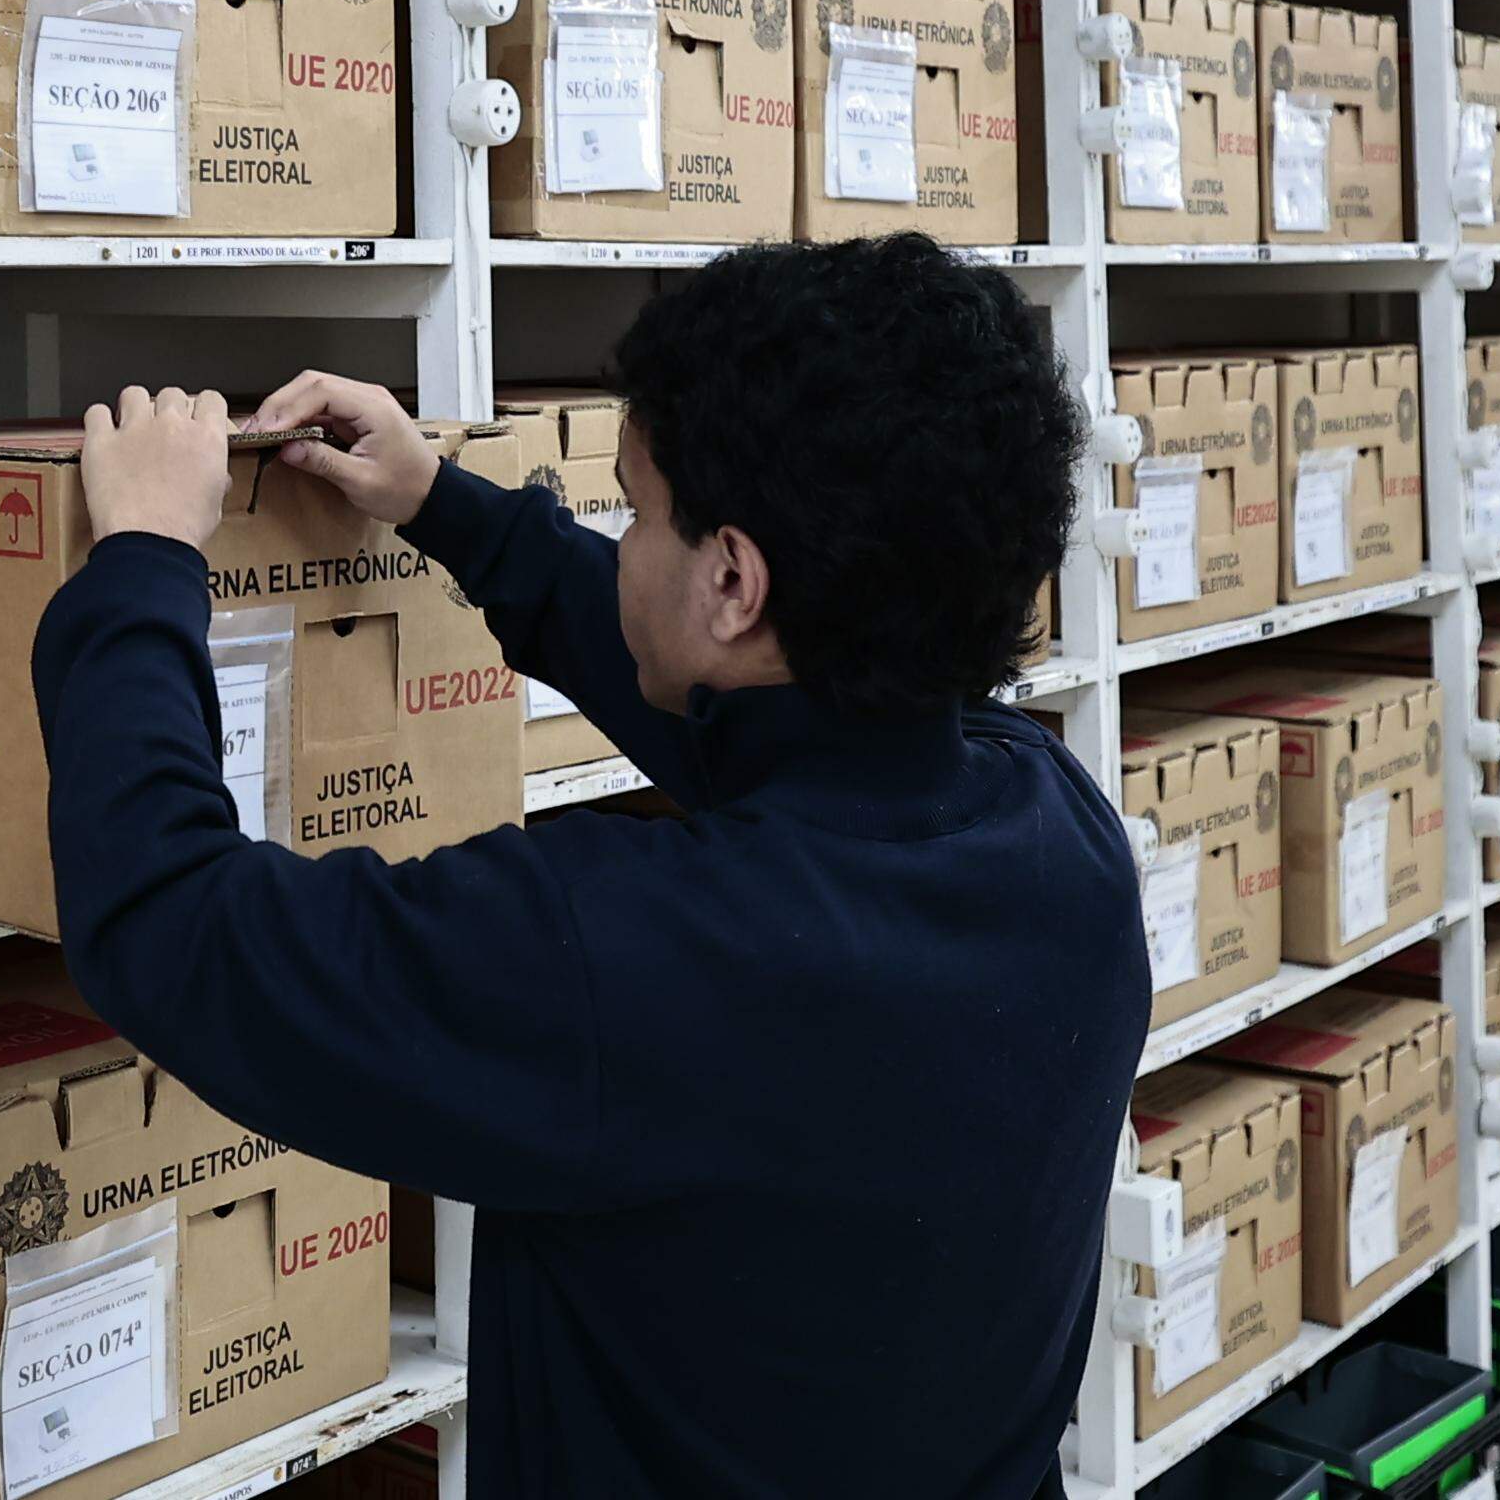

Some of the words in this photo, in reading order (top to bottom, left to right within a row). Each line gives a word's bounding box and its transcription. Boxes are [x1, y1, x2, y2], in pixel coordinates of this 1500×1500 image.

[287, 52, 325, 90] UE
[335, 57, 394, 95] 2020
[49, 83, 120, 113] SEÇÃO
[127, 88, 167, 114] 206ª
[725, 94, 753, 124] UE
[756, 98, 794, 128] 2020
[213, 125, 300, 156] JUSTIÇA
[961, 112, 983, 138] UE
[199, 157, 313, 187] ELEITORAL
[677, 154, 734, 178] JUSTIÇA
[923, 165, 969, 188] JUSTIÇA
[669, 178, 742, 205] ELEITORAL
[1191, 431, 1246, 455] ELETRÔNICA
[268, 548, 431, 595] ELETRÔNICA
[404, 666, 516, 717] UE2022
[317, 760, 415, 803] JUSTIÇA
[300, 794, 429, 844] ELEITORAL
[1239, 872, 1256, 899] UE
[1210, 926, 1245, 955] JUSTIÇA
[1204, 945, 1250, 976] ELEITORAL
[83, 1171, 155, 1220] URNA
[279, 1235, 319, 1278] UE
[327, 1209, 390, 1264] 2020
[1258, 1246, 1275, 1275] UE
[17, 1341, 93, 1389] SEÇÃO
[99, 1318, 142, 1358] 074ª
[203, 1320, 292, 1376] JUSTIÇA
[189, 1349, 304, 1416] ELEITORAL
